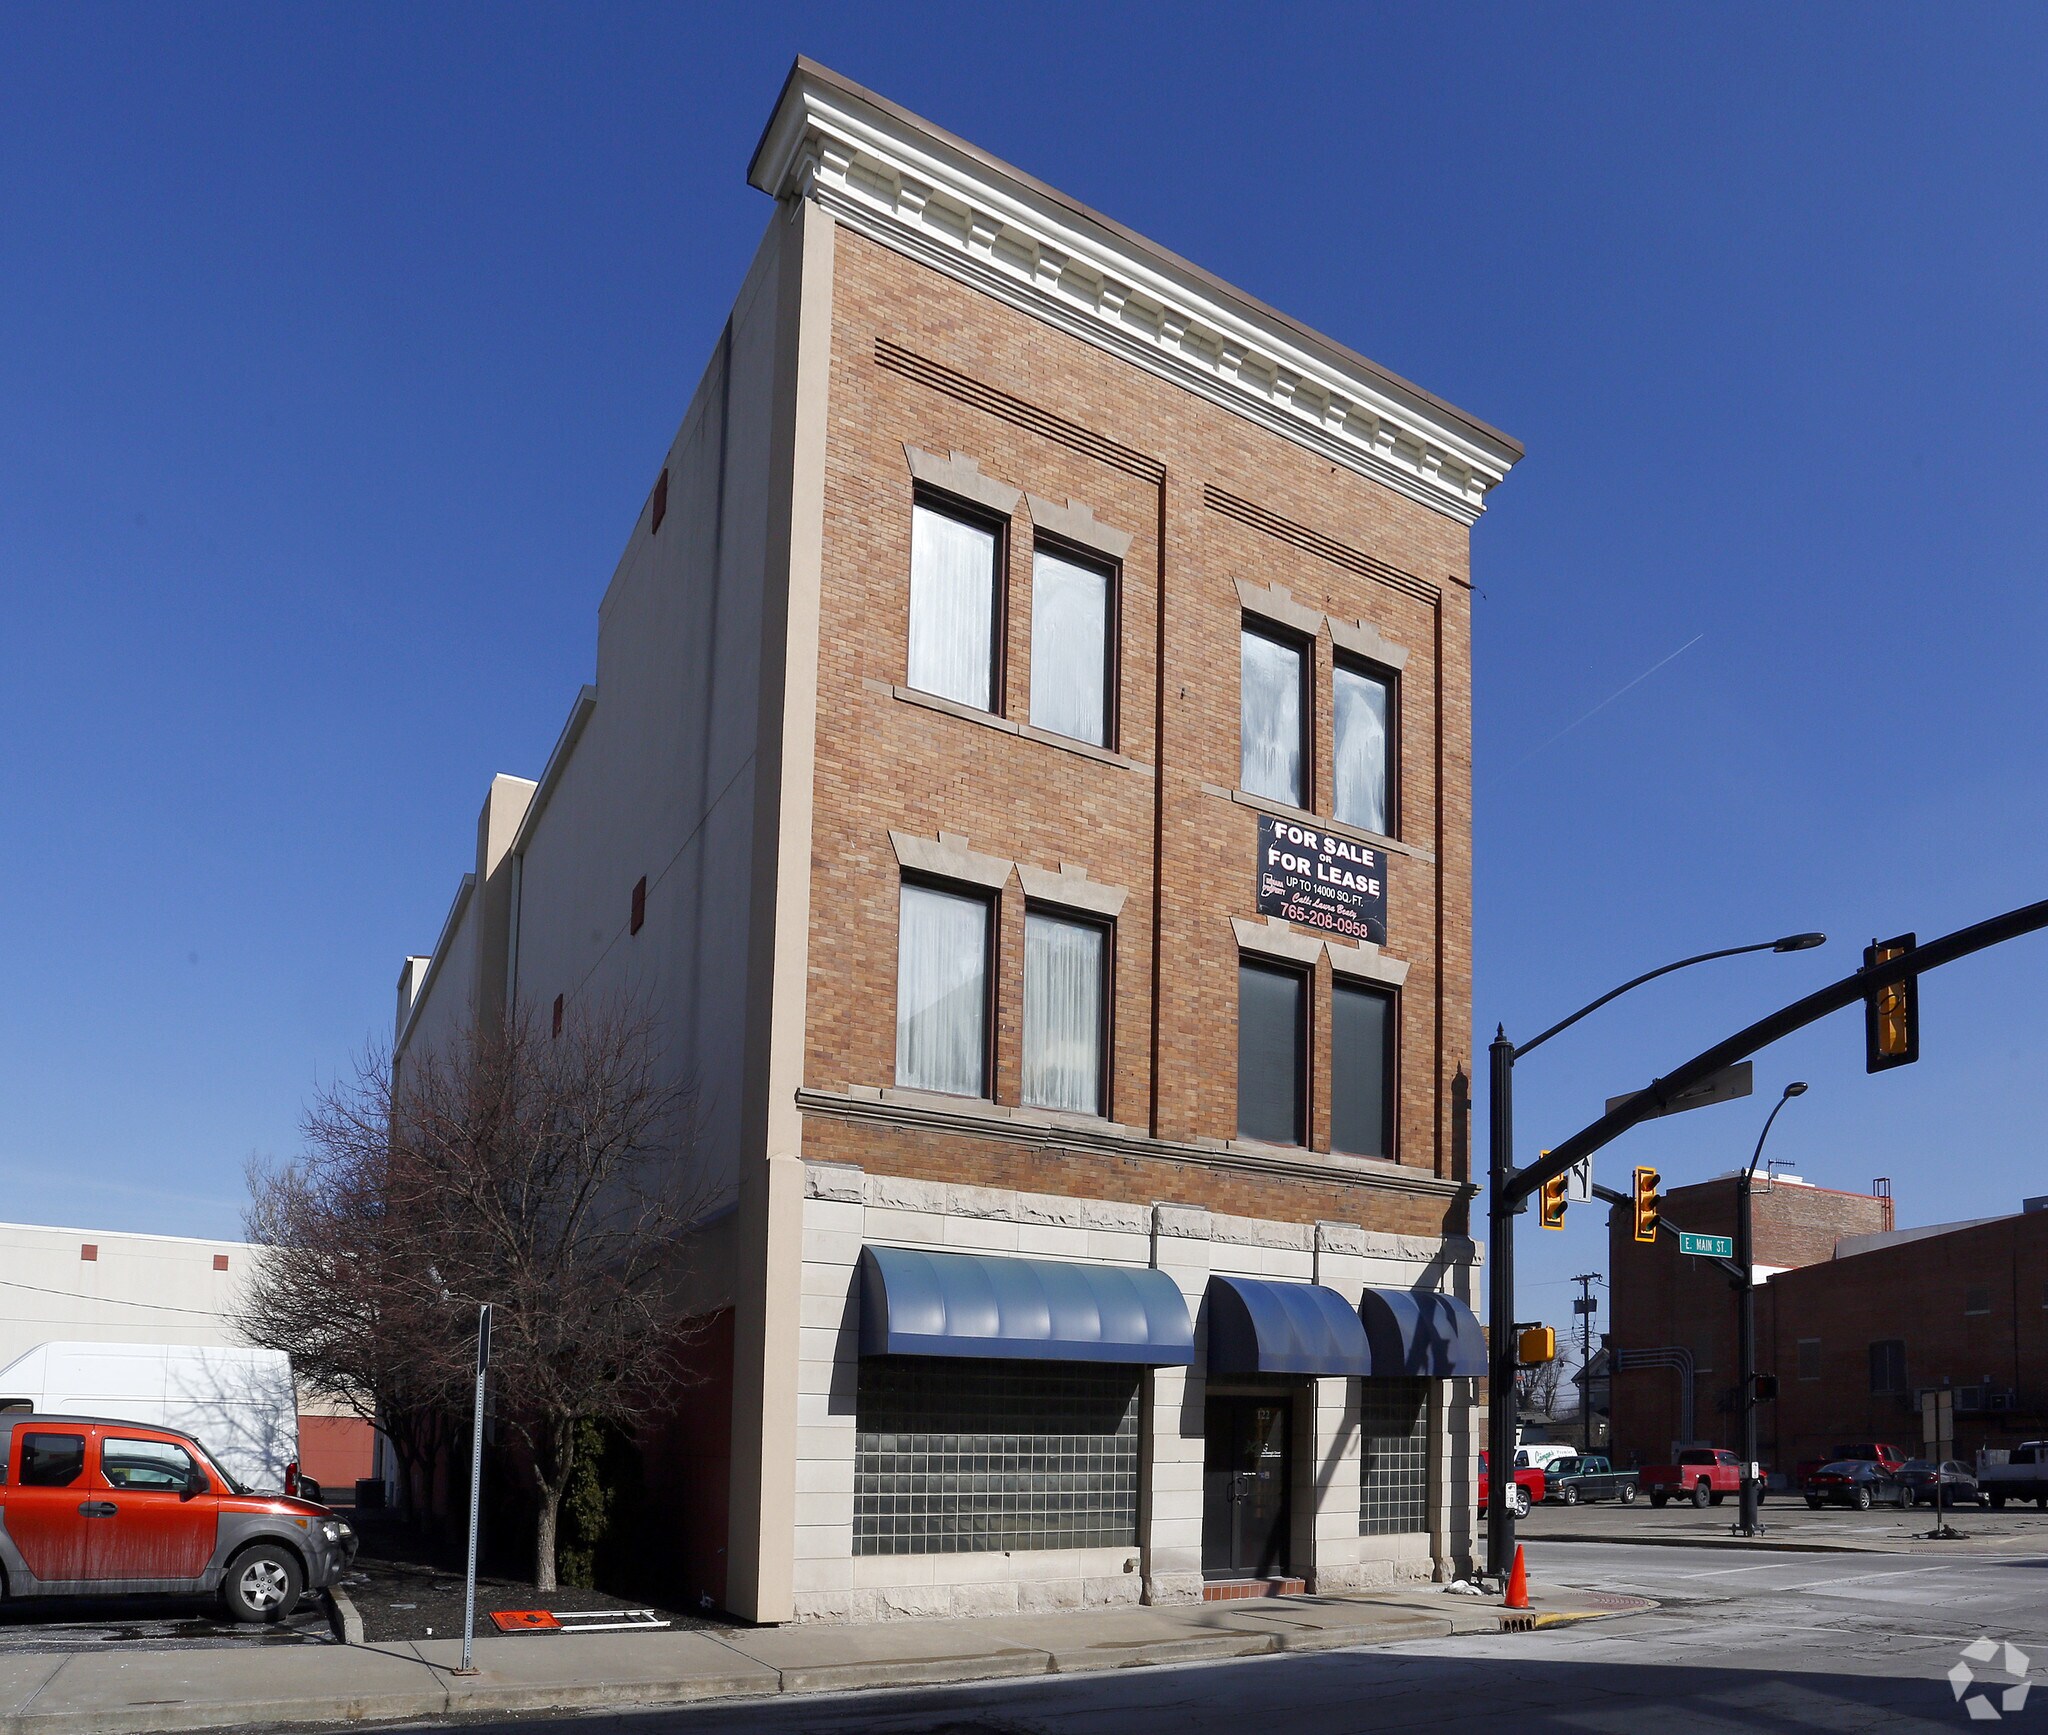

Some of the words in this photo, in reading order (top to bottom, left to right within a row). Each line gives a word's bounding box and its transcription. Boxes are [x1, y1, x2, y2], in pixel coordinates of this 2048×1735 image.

[1275, 822, 1318, 850] FOR
[1323, 837, 1374, 868] SALE
[1319, 853, 1332, 864] OR
[1268, 847, 1311, 876] FOR
[1317, 863, 1380, 897] LEASE
[1286, 876, 1298, 887] UP
[1299, 879, 1311, 892] TO
[1313, 883, 1336, 899] 14000
[1352, 894, 1364, 907] FT.
[1312, 898, 1336, 912] Laura
[1280, 901, 1368, 938] 765-208-0958
[1685, 1238, 1692, 1249] E.
[1697, 1239, 1712, 1251] MAIN
[1717, 1241, 1727, 1253] ST.
